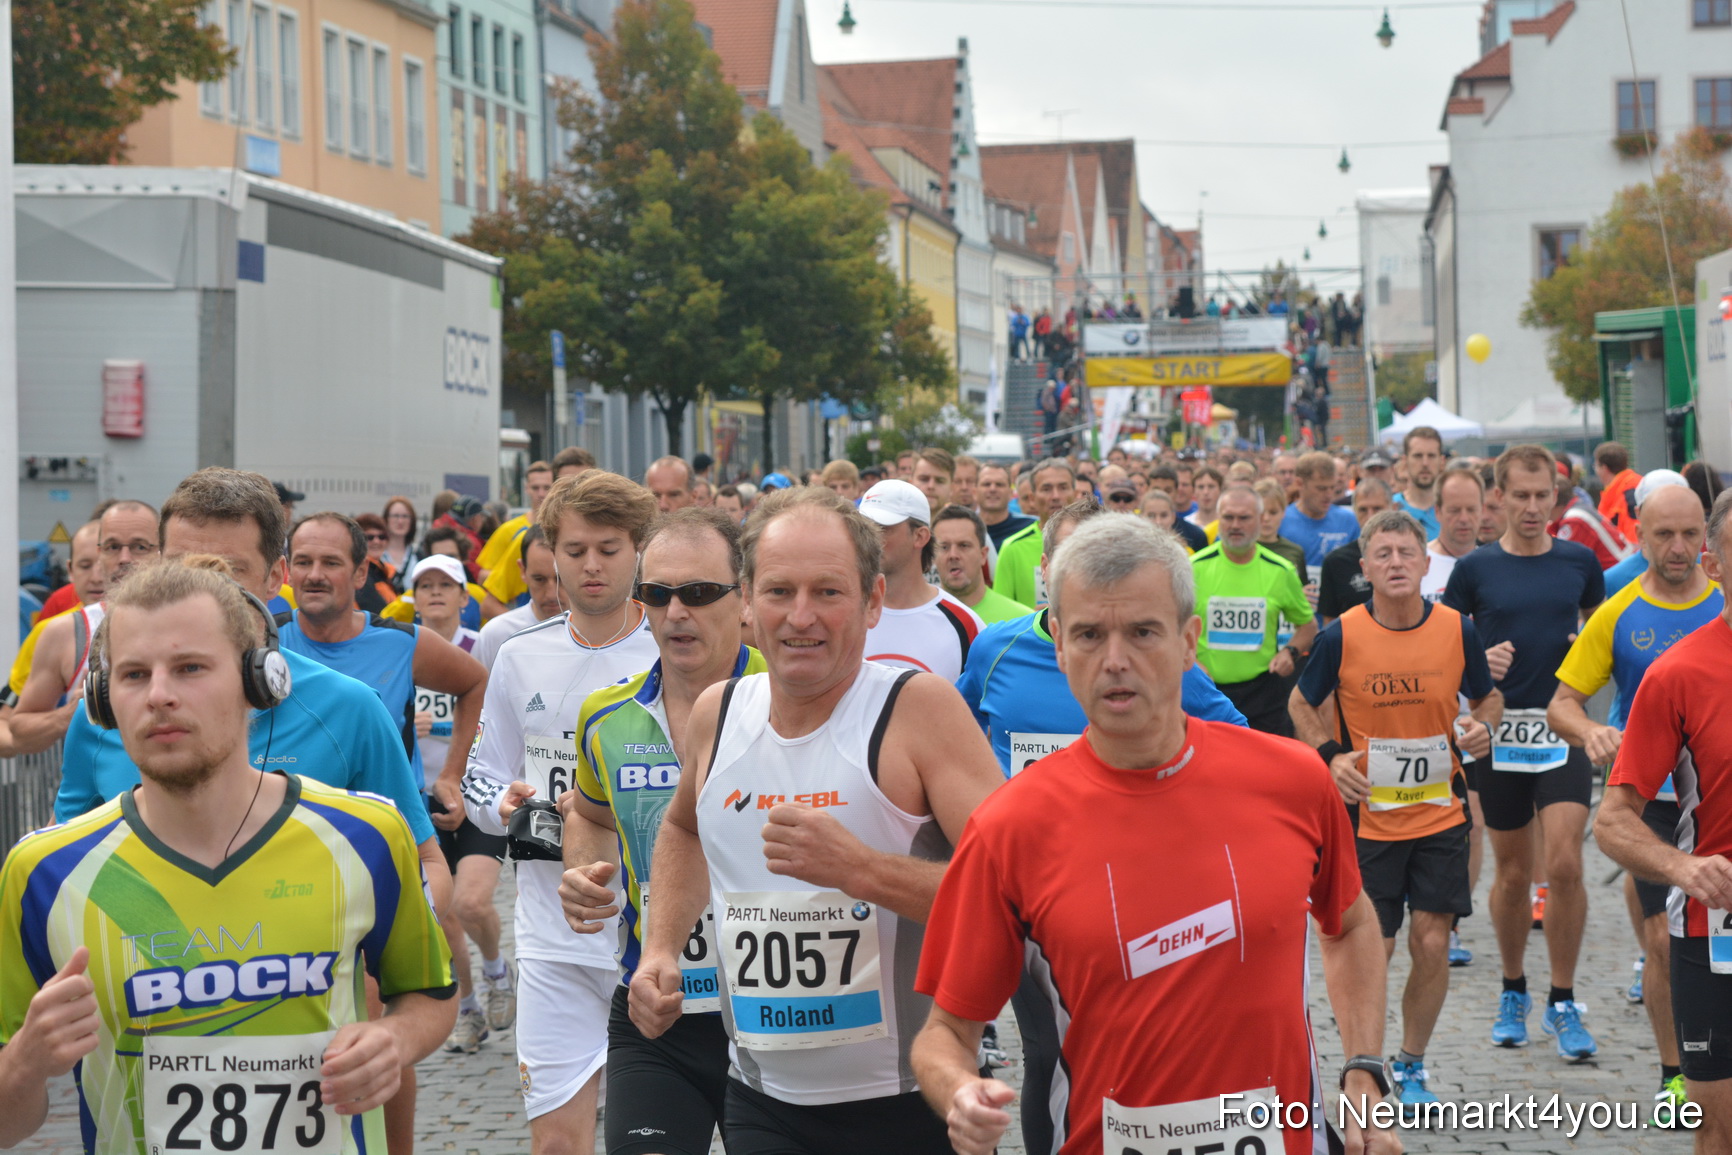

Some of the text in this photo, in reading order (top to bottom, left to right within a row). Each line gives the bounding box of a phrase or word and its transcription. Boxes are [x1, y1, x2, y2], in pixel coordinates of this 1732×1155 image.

[1153, 361, 1223, 380] START
[1213, 609, 1261, 630] 3308
[1372, 678, 1425, 697] OEXL
[526, 704, 546, 712] adidas
[526, 745, 551, 760] PARTL
[1013, 743, 1048, 754] PARTL
[1371, 744, 1438, 753] PARTL Neumarkt
[1508, 750, 1552, 761] Christian
[1396, 757, 1428, 783] 70
[1395, 790, 1425, 802] Xaver
[727, 907, 844, 922] PARTL Neumarkt
[120, 922, 263, 963] TEAM
[1159, 923, 1204, 956] DEHN
[735, 930, 861, 989] 2057
[124, 952, 340, 1018] BOCK
[760, 1004, 834, 1028] Roland
[149, 1054, 315, 1072] PARTL Neumarkt
[165, 1080, 326, 1151] 2873
[1107, 1115, 1155, 1139] PARTL
